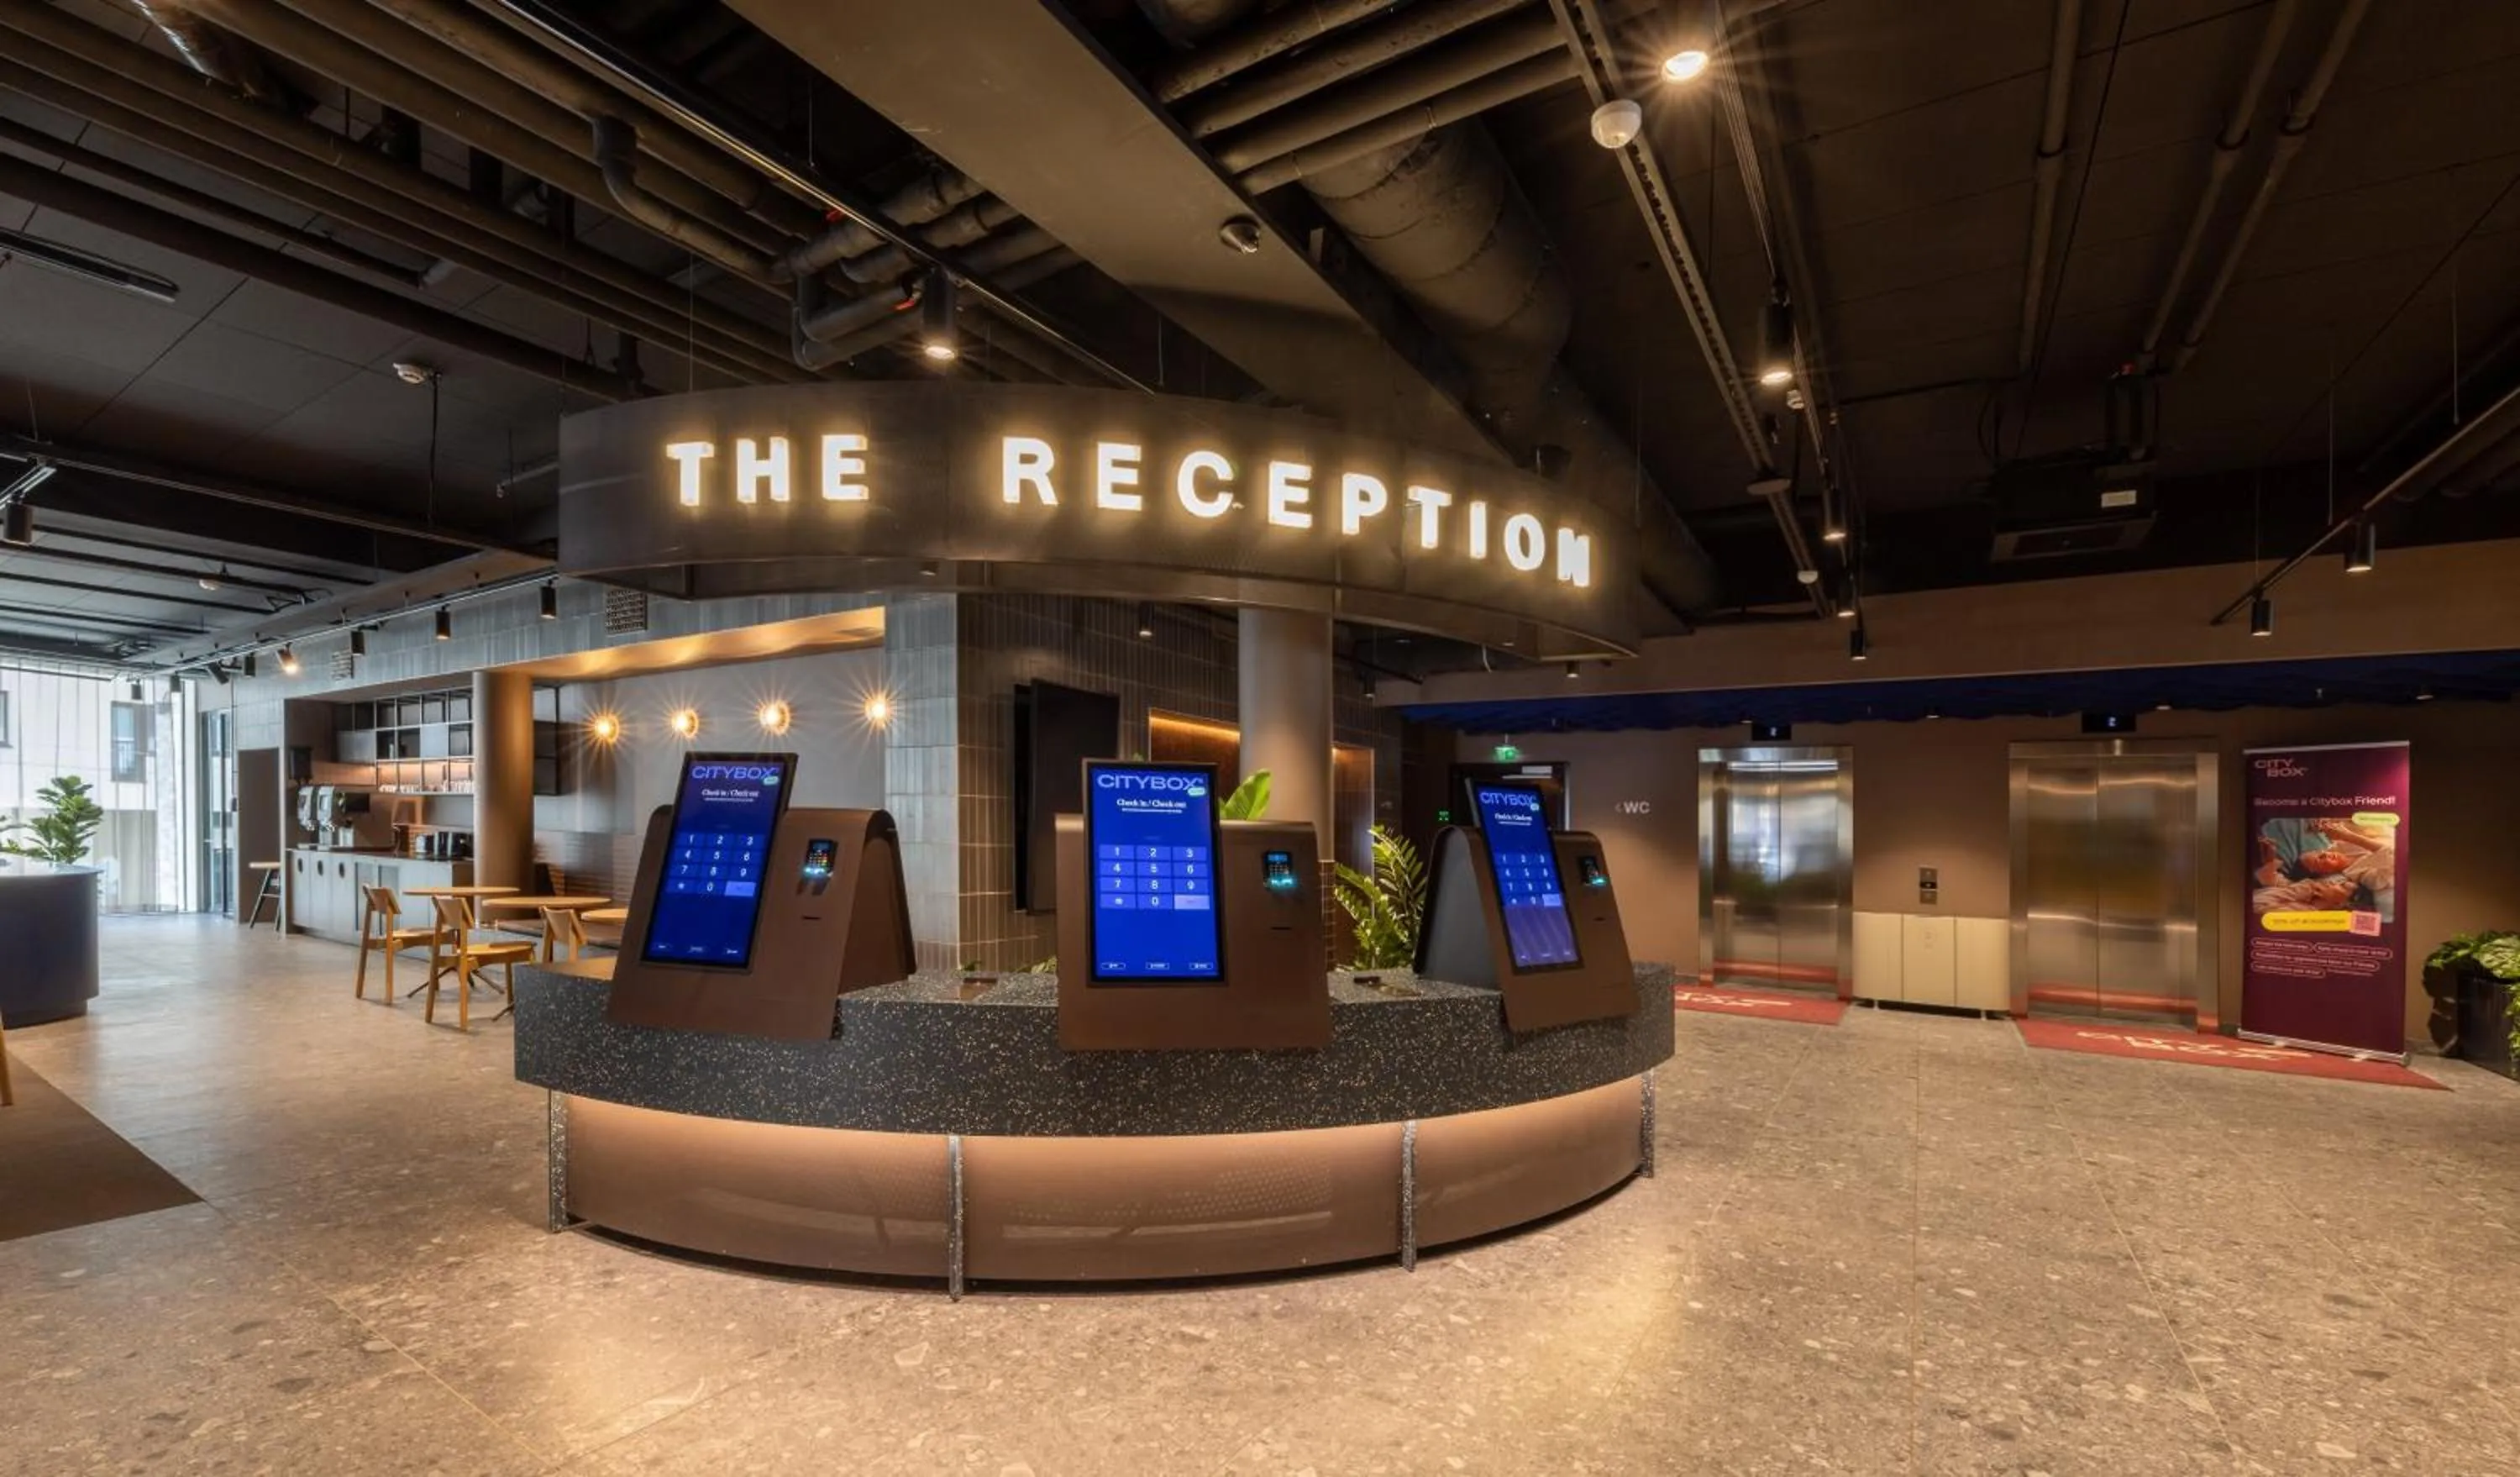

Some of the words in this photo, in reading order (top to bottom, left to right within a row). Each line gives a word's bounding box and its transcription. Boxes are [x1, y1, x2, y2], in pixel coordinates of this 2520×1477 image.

[666, 434, 869, 506] THE
[1002, 436, 1590, 587] RECEPTION
[2255, 758, 2293, 769] CITY
[692, 765, 777, 780] CITYBOX
[2266, 767, 2306, 777] BOX
[1097, 774, 1201, 791] CITYBOX
[1480, 792, 1535, 807] CITYBOX
[2309, 797, 2352, 807] Citybox
[2355, 796, 2396, 806] Friend!
[1624, 801, 1650, 814] WC
[717, 834, 723, 844] 2
[747, 836, 753, 846] 3
[714, 851, 720, 860] 5
[743, 851, 750, 861] 6
[1149, 848, 1157, 857] 2
[1186, 848, 1193, 858] 3
[681, 865, 688, 874] 7
[740, 868, 747, 877] 9
[1113, 863, 1121, 873] 4
[707, 881, 714, 892] 0
[1115, 879, 1121, 888] 7
[1151, 880, 1158, 890] 8
[1187, 880, 1194, 890] 9
[1152, 896, 1159, 907] 0
